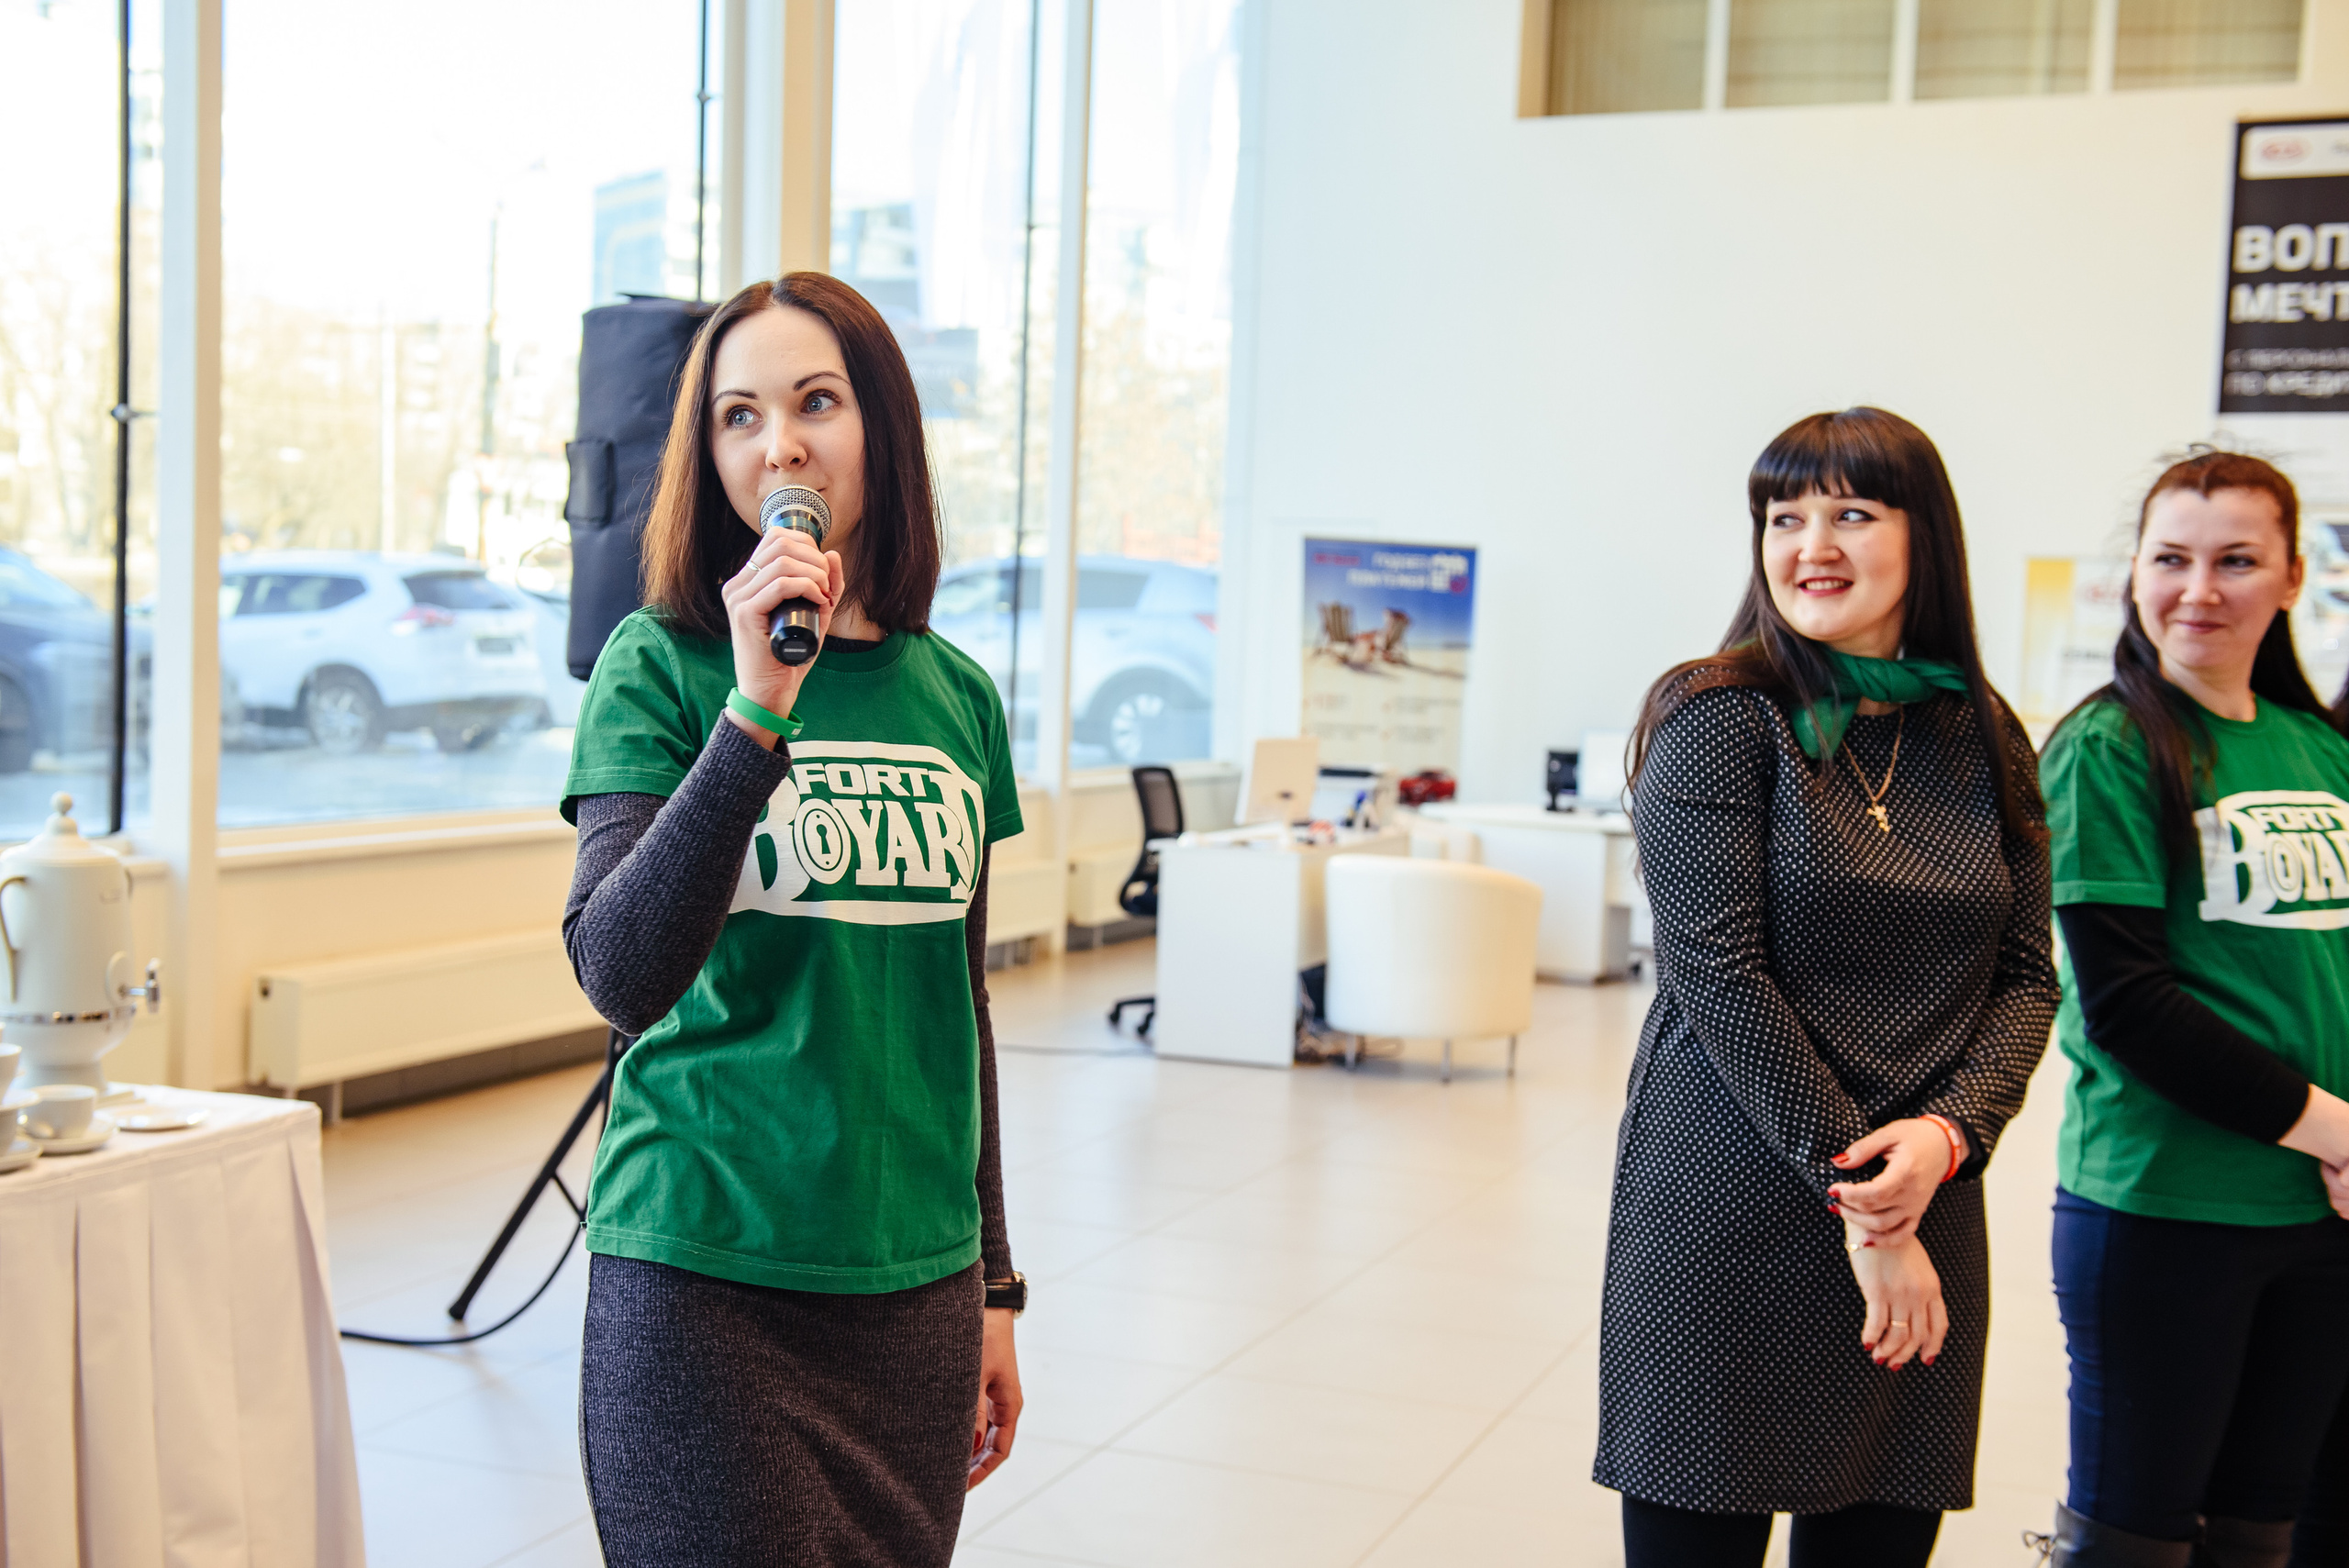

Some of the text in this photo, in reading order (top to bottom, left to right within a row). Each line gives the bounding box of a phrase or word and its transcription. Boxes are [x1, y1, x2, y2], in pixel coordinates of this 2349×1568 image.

[2232, 223, 2349, 272] ВОП
[792, 762, 929, 796] FORT
[2249, 806, 2337, 831] FORT
